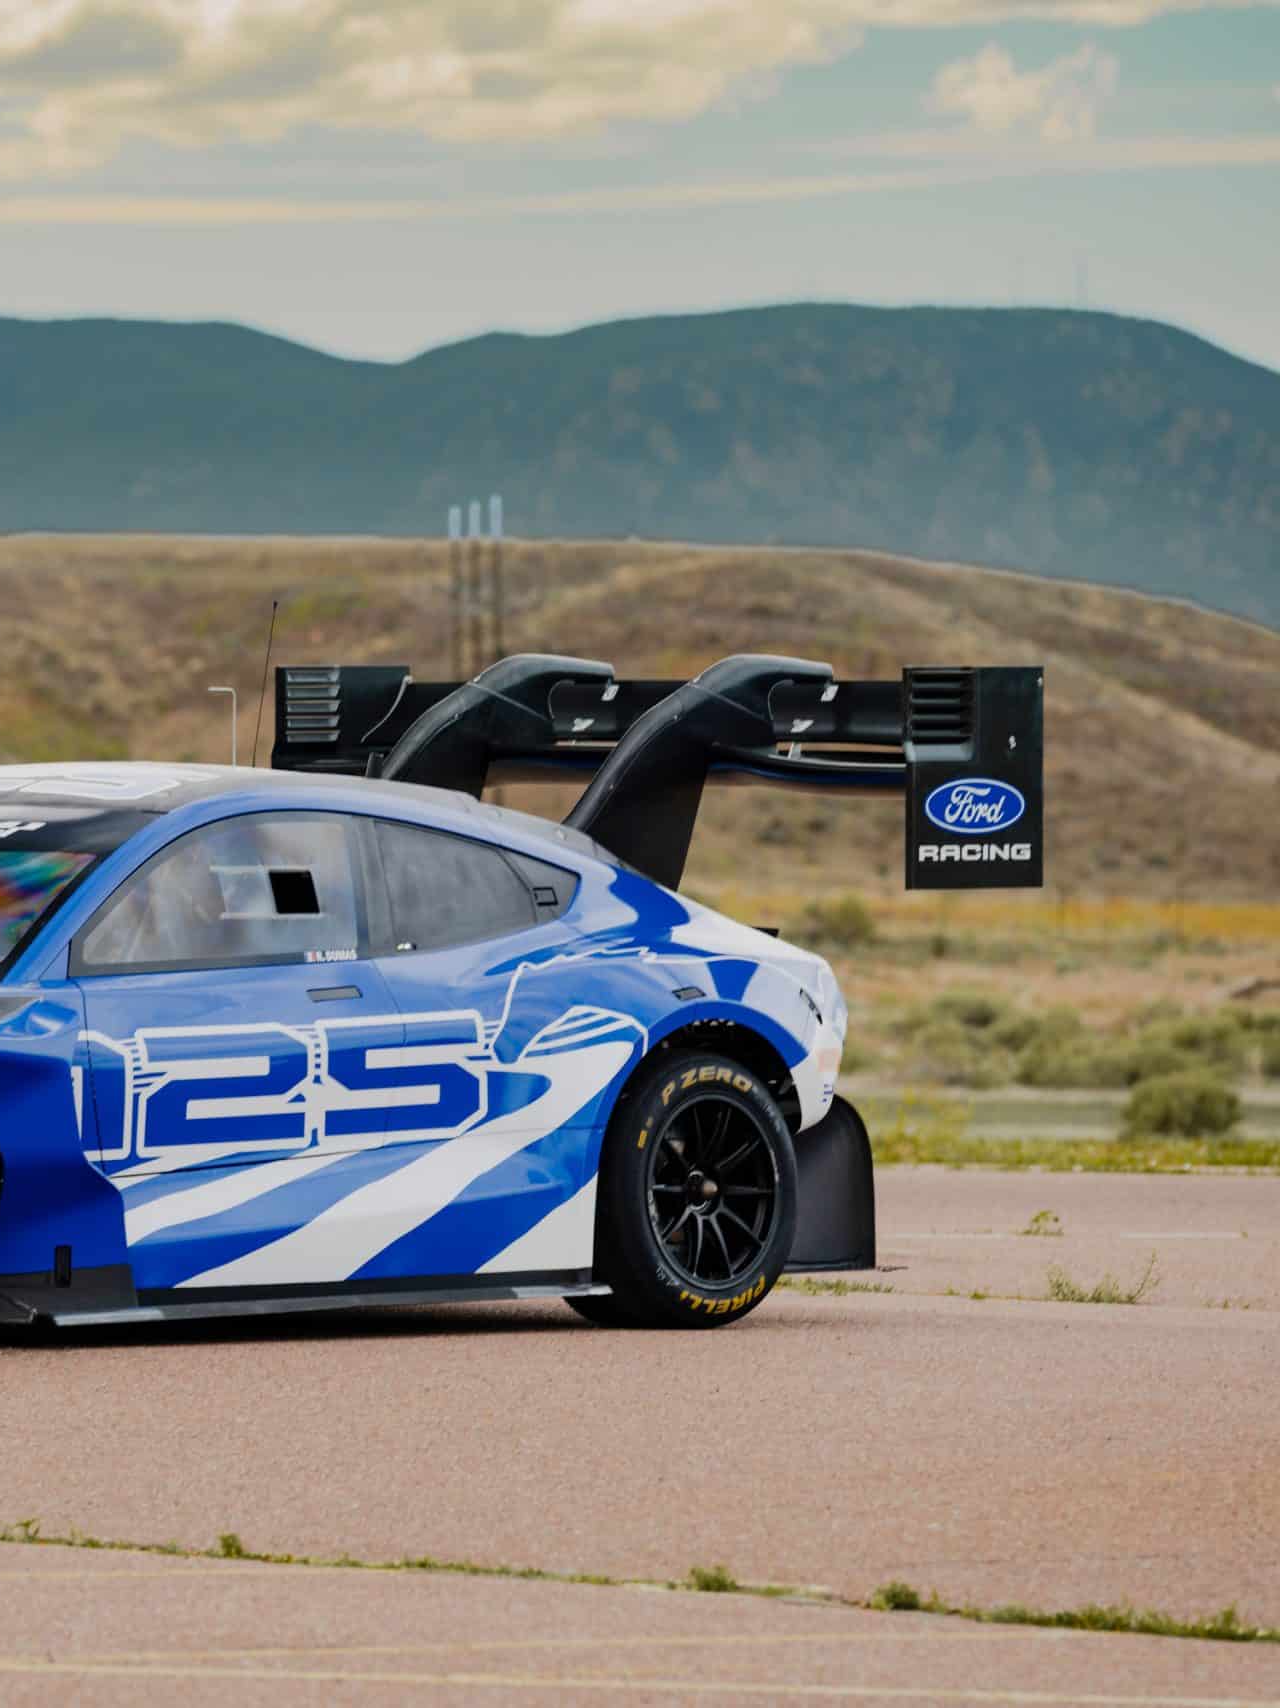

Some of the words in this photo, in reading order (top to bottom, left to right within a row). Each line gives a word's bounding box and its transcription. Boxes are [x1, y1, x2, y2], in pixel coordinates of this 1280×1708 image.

[944, 785, 1006, 824] Ford
[918, 843, 1032, 862] RACING
[661, 1081, 675, 1105] P
[680, 1065, 753, 1093] ZERO
[679, 1274, 767, 1315] PIRELLI
